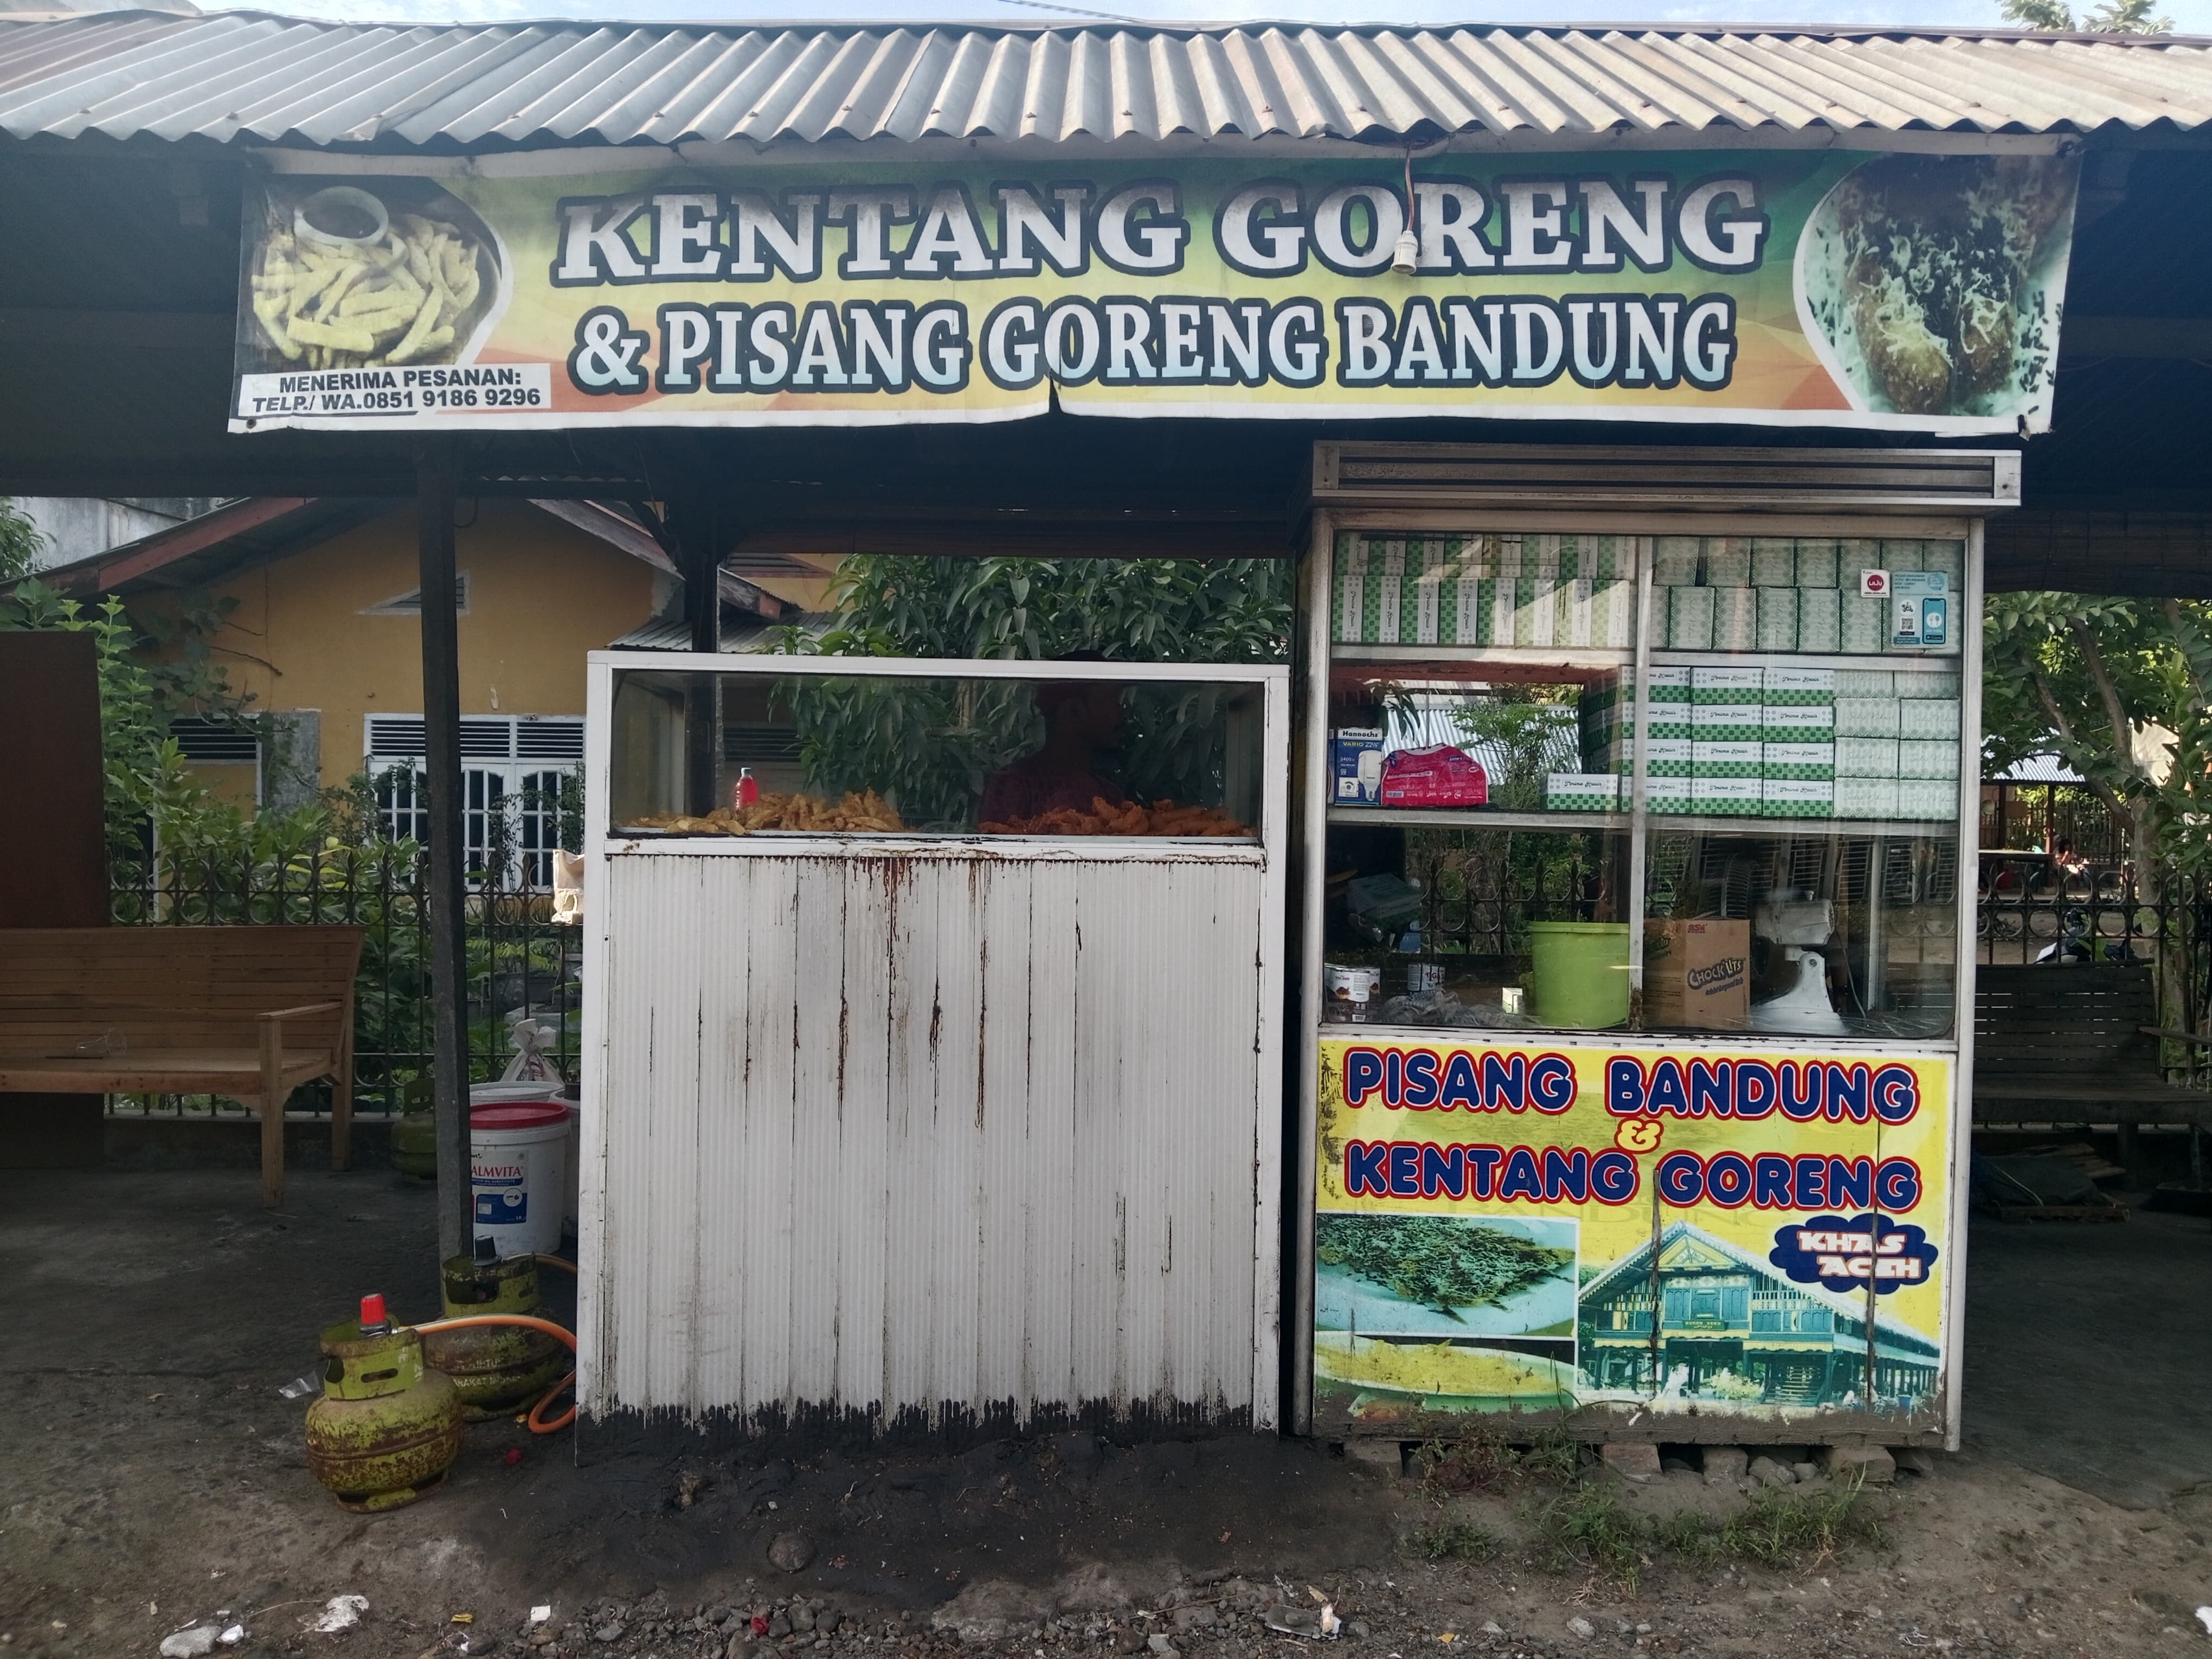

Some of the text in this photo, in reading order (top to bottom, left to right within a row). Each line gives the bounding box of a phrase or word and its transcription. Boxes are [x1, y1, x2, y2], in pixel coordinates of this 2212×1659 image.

[550, 173, 1769, 287] KENTANG GORENG
[567, 292, 1738, 394] & PISANG GORENG BANDUNG
[280, 369, 521, 393] MENERIMA PESANAN:
[422, 389, 478, 407] 9186
[485, 388, 541, 406] 9296
[1343, 1046, 1920, 1126] PISANG BANDUNG
[1614, 1116, 1664, 1155] &
[472, 1165, 521, 1177] ALMVITA
[1345, 1139, 1922, 1214] KENTANG GORENG
[1797, 1230, 1907, 1254] KHAS
[1817, 1255, 1921, 1279] ACEH
